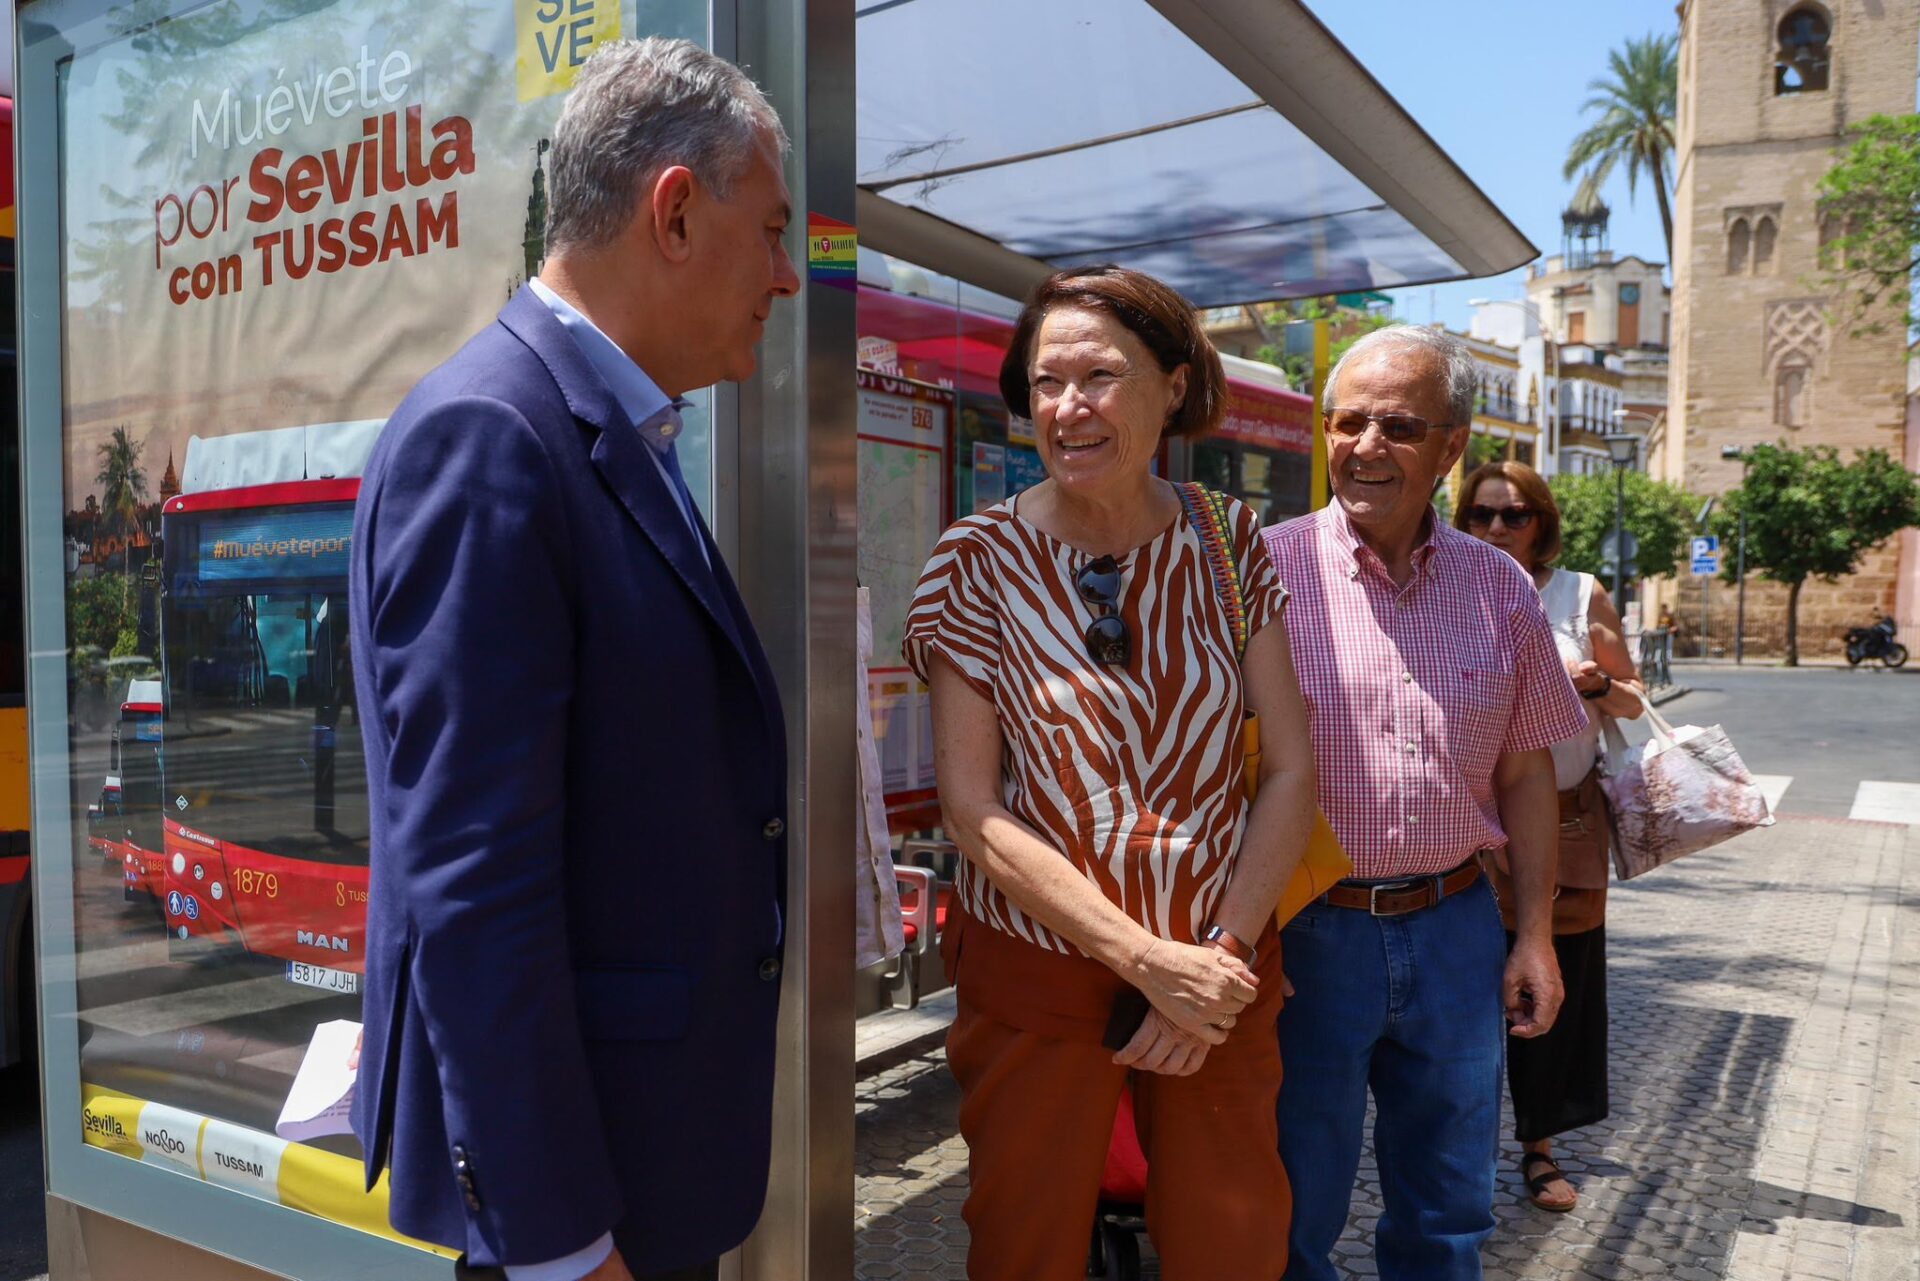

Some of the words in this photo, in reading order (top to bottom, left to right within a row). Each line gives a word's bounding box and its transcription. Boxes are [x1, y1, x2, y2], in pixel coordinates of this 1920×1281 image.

[535, 16, 595, 73] VE
[191, 45, 412, 159] Muévete
[155, 175, 240, 270] por
[246, 104, 476, 223] Sevilla
[169, 254, 243, 305] con
[253, 190, 459, 286] TUSSAM
[912, 407, 933, 429] 576
[213, 535, 352, 558] #muévetepor
[232, 867, 279, 898] 1879
[296, 929, 350, 952] MAN
[294, 964, 326, 985] 5817
[329, 971, 355, 992] JJH
[214, 1151, 265, 1178] TUSSAM
